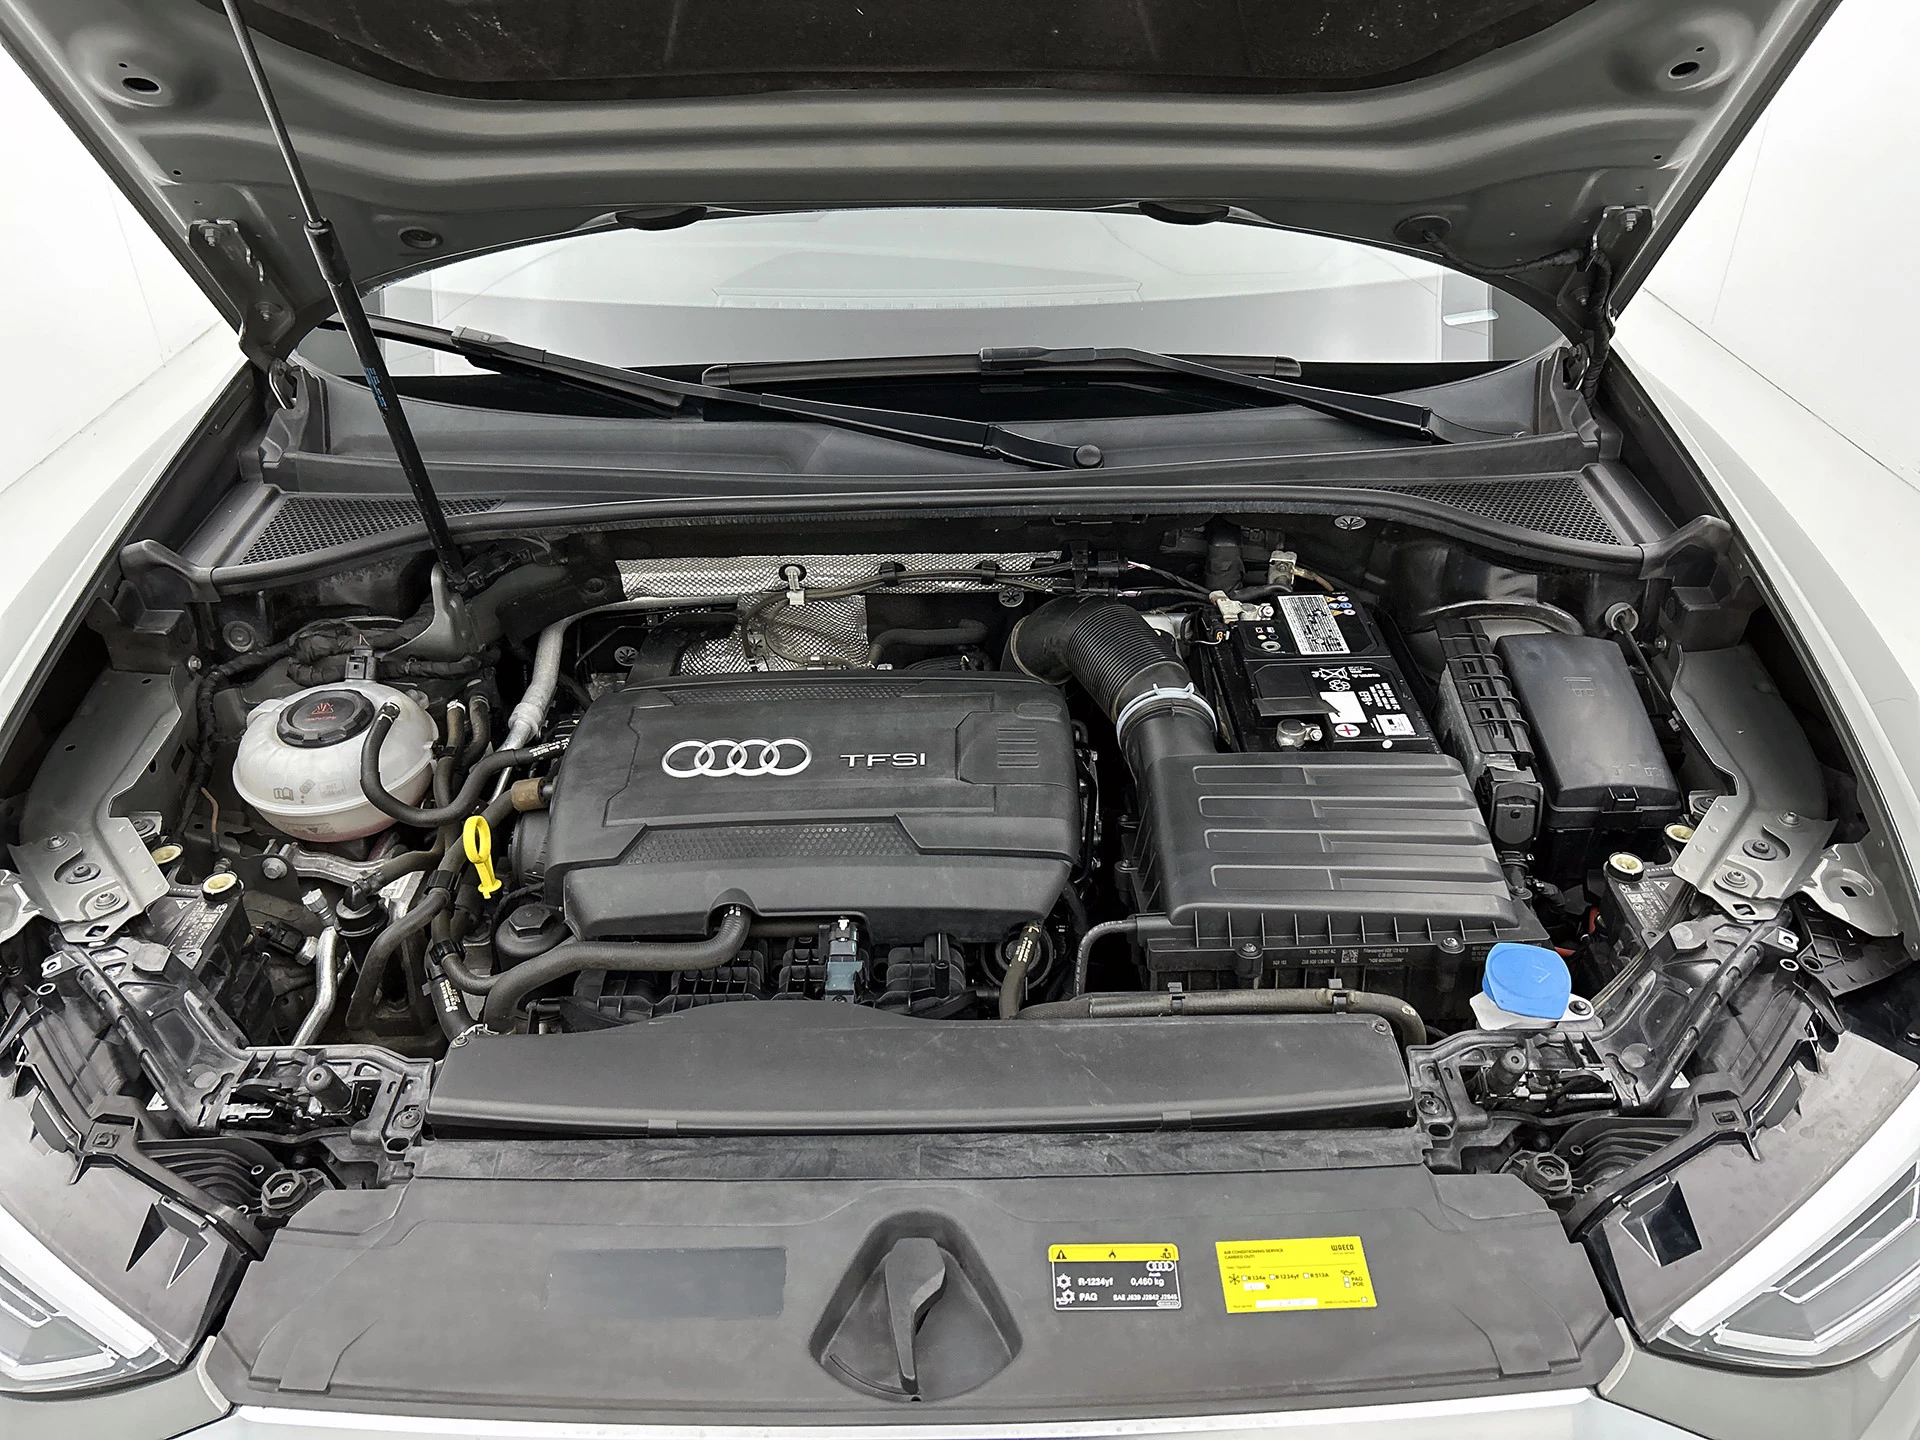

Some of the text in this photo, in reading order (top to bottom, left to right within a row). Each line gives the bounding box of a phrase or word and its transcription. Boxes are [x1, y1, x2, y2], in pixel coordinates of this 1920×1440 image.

[840, 752, 926, 769] TFSI
[1330, 1243, 1355, 1251] WAECO
[1077, 1277, 1114, 1287] R-1234yf
[1154, 1277, 1165, 1287] kg
[1079, 1292, 1098, 1301] PAG
